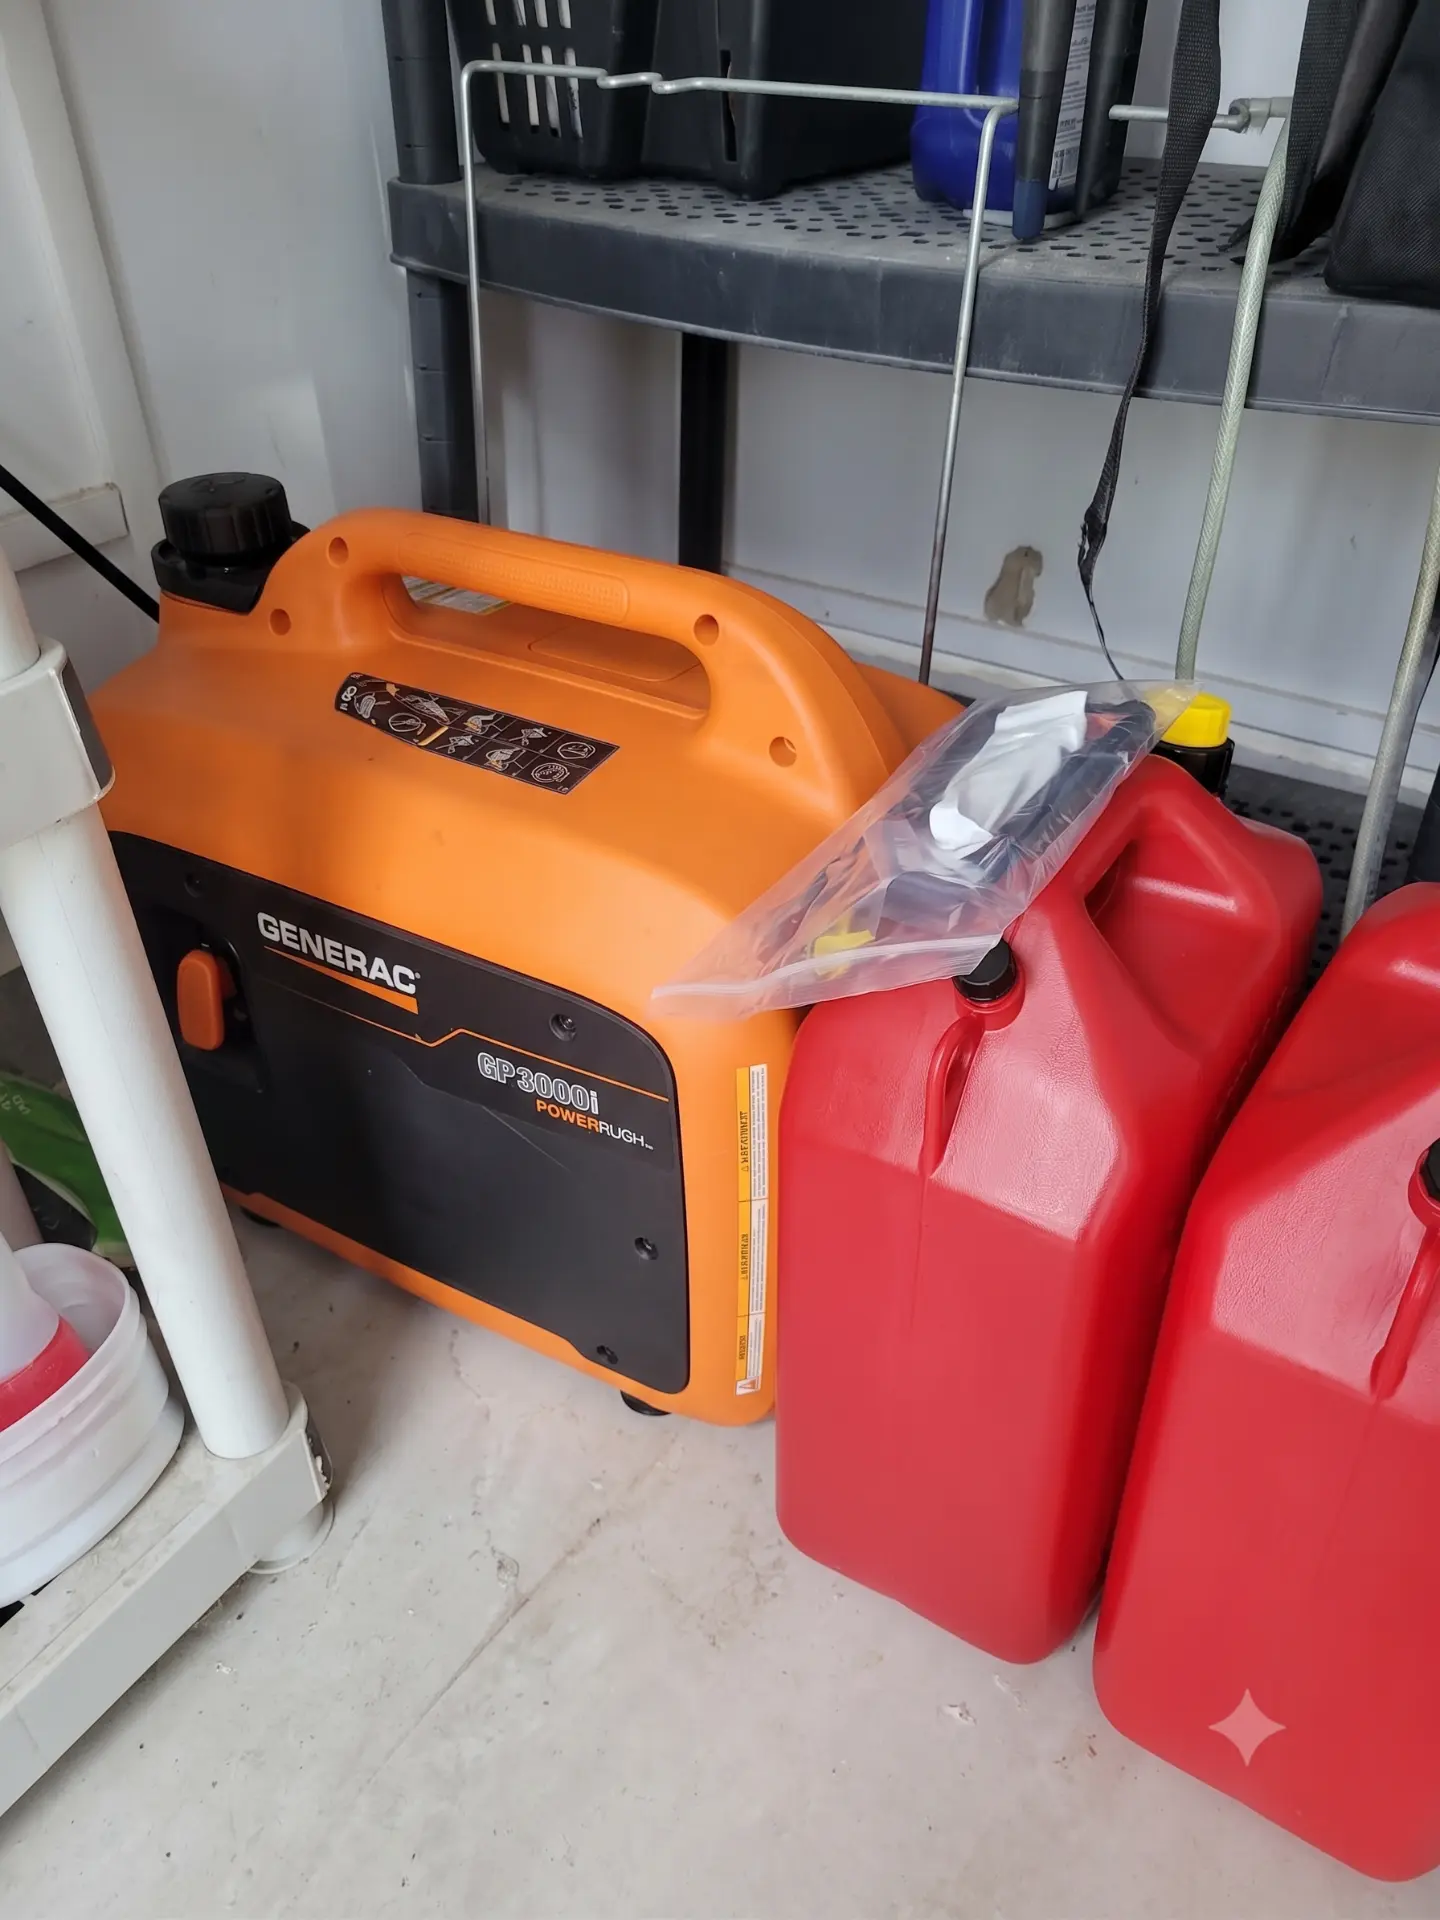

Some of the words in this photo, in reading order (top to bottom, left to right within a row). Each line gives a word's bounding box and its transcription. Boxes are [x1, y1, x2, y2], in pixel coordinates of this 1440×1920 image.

[257, 911, 416, 995] GENERAC
[477, 1052, 599, 1115] GP3000i
[536, 1099, 645, 1147] POWERRUGH
